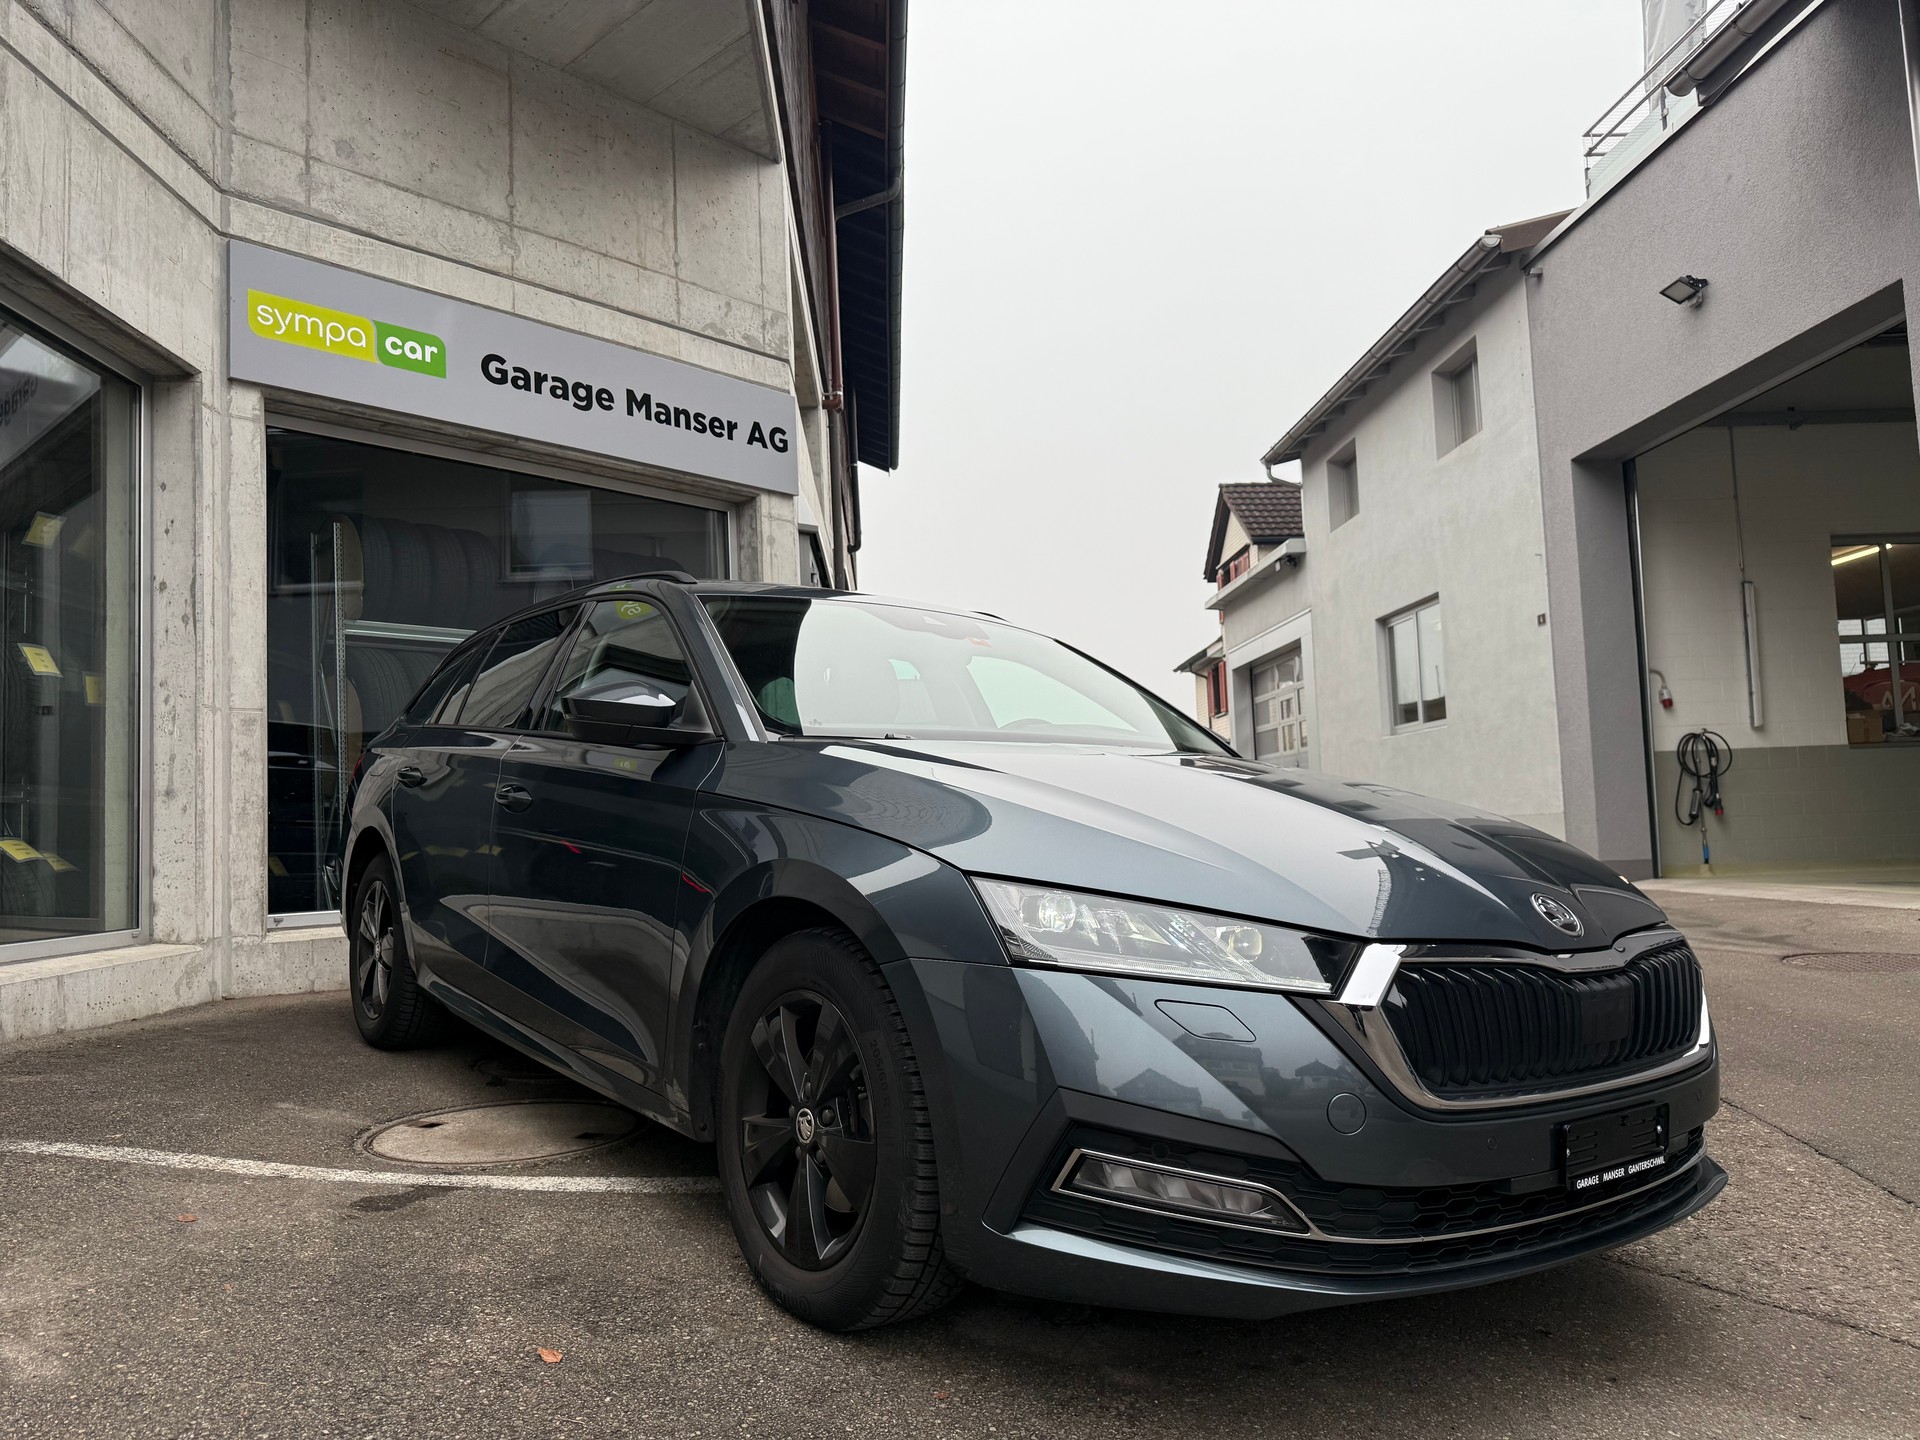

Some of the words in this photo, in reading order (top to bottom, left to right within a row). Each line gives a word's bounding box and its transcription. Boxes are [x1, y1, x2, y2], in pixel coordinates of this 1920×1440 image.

[257, 305, 366, 347] sympa
[385, 336, 437, 363] car
[481, 353, 615, 412] Garage
[626, 388, 738, 441] Manser
[747, 421, 789, 454] AG
[1576, 1175, 1599, 1189] GARAGE
[1603, 1168, 1625, 1182] MANSER
[1628, 1155, 1665, 1174] GANTERSCHWIL
